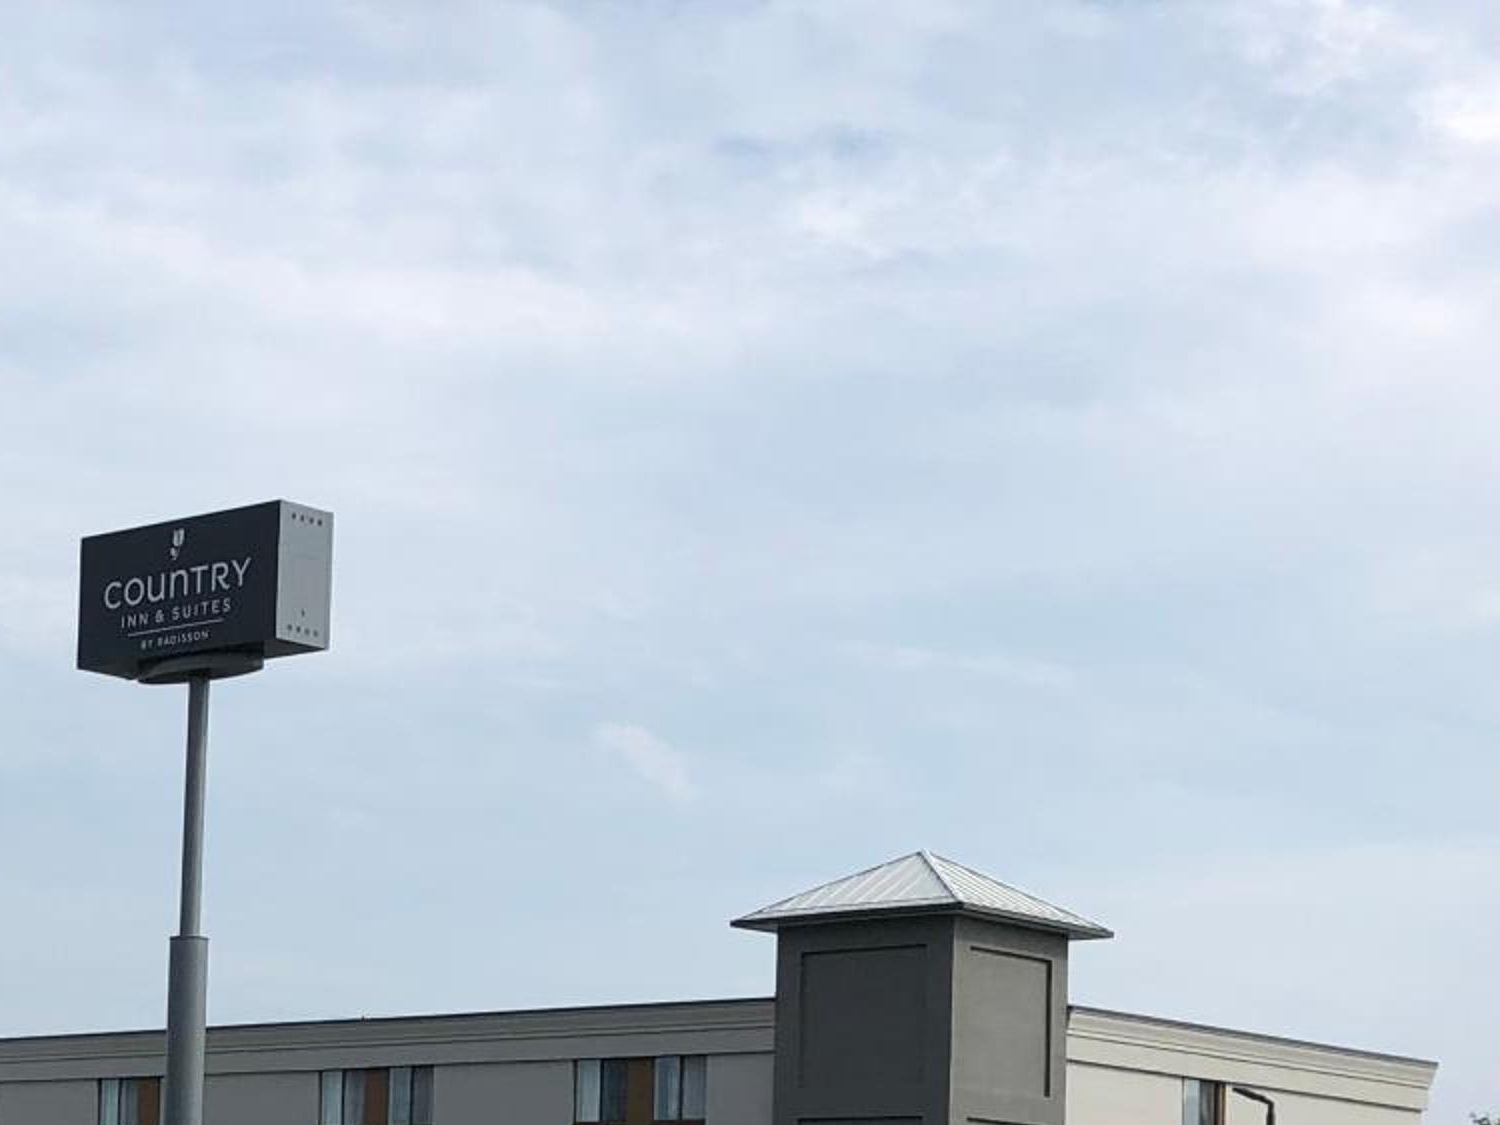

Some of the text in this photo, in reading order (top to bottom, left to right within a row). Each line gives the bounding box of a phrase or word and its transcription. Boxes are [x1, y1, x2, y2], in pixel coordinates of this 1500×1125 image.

[104, 557, 252, 609] COUNTRY
[121, 597, 231, 629] INN & SUITES
